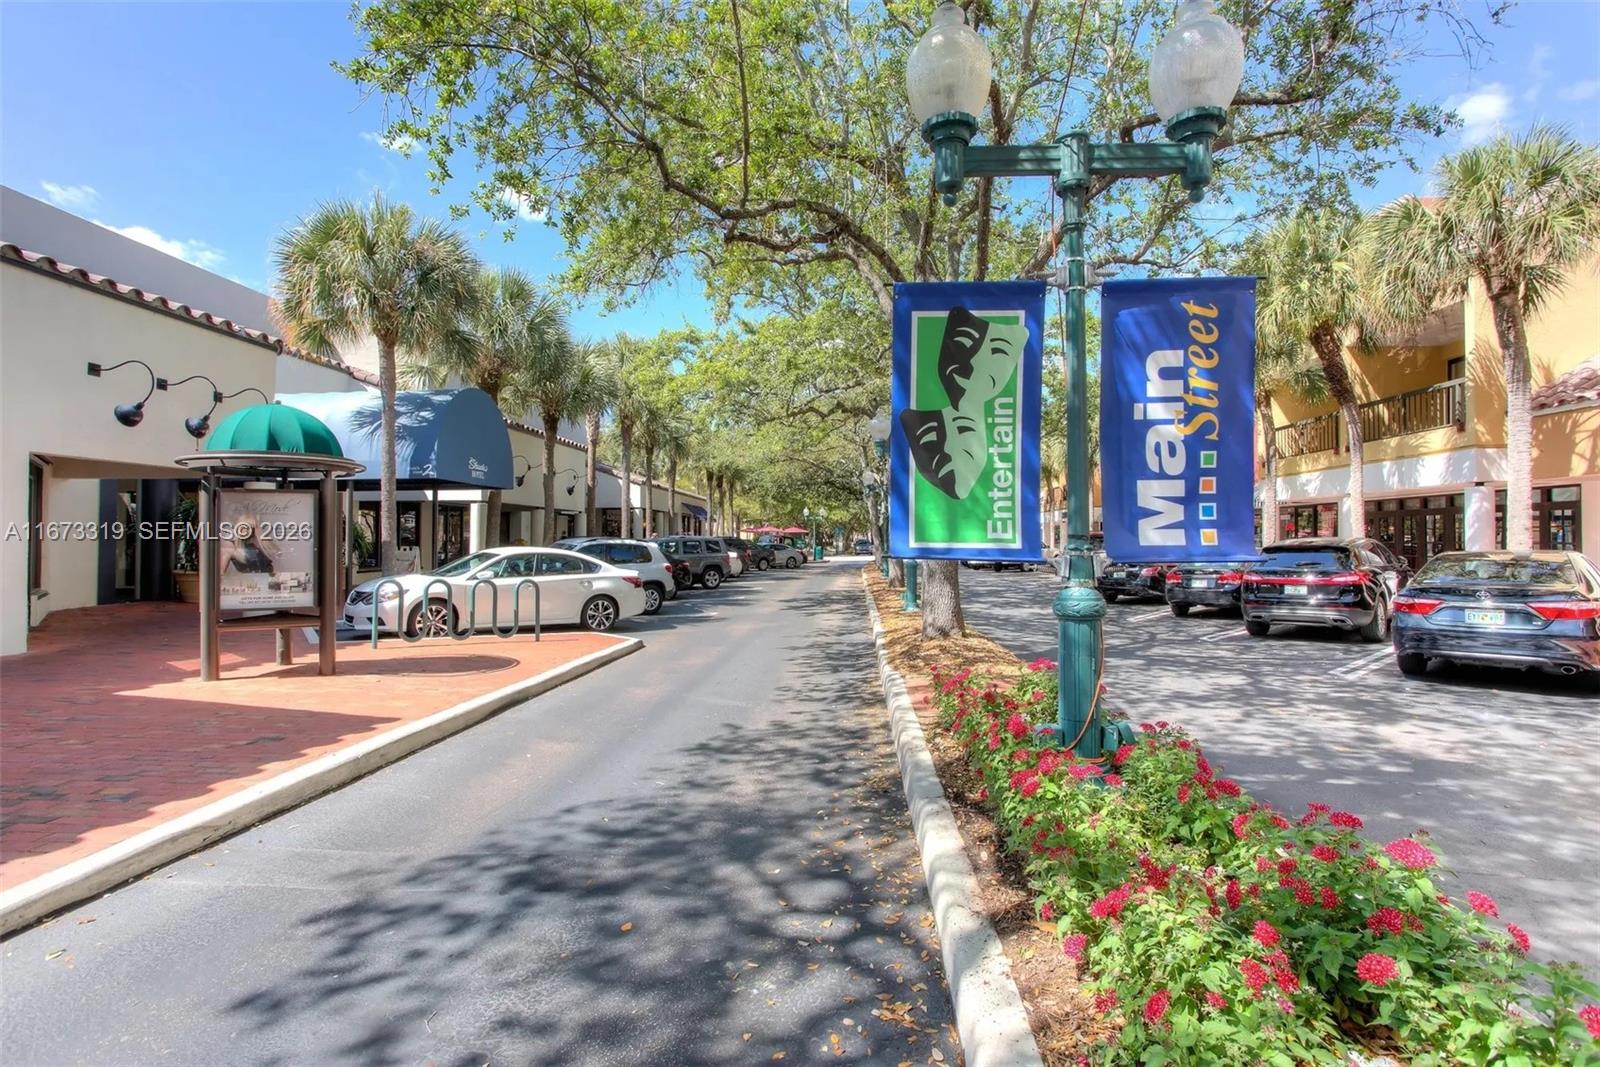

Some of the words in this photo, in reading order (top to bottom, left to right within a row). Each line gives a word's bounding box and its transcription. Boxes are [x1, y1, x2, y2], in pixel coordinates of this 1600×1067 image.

[1173, 300, 1220, 441] Street
[986, 396, 1014, 540] Entertain
[1133, 349, 1187, 546] Main
